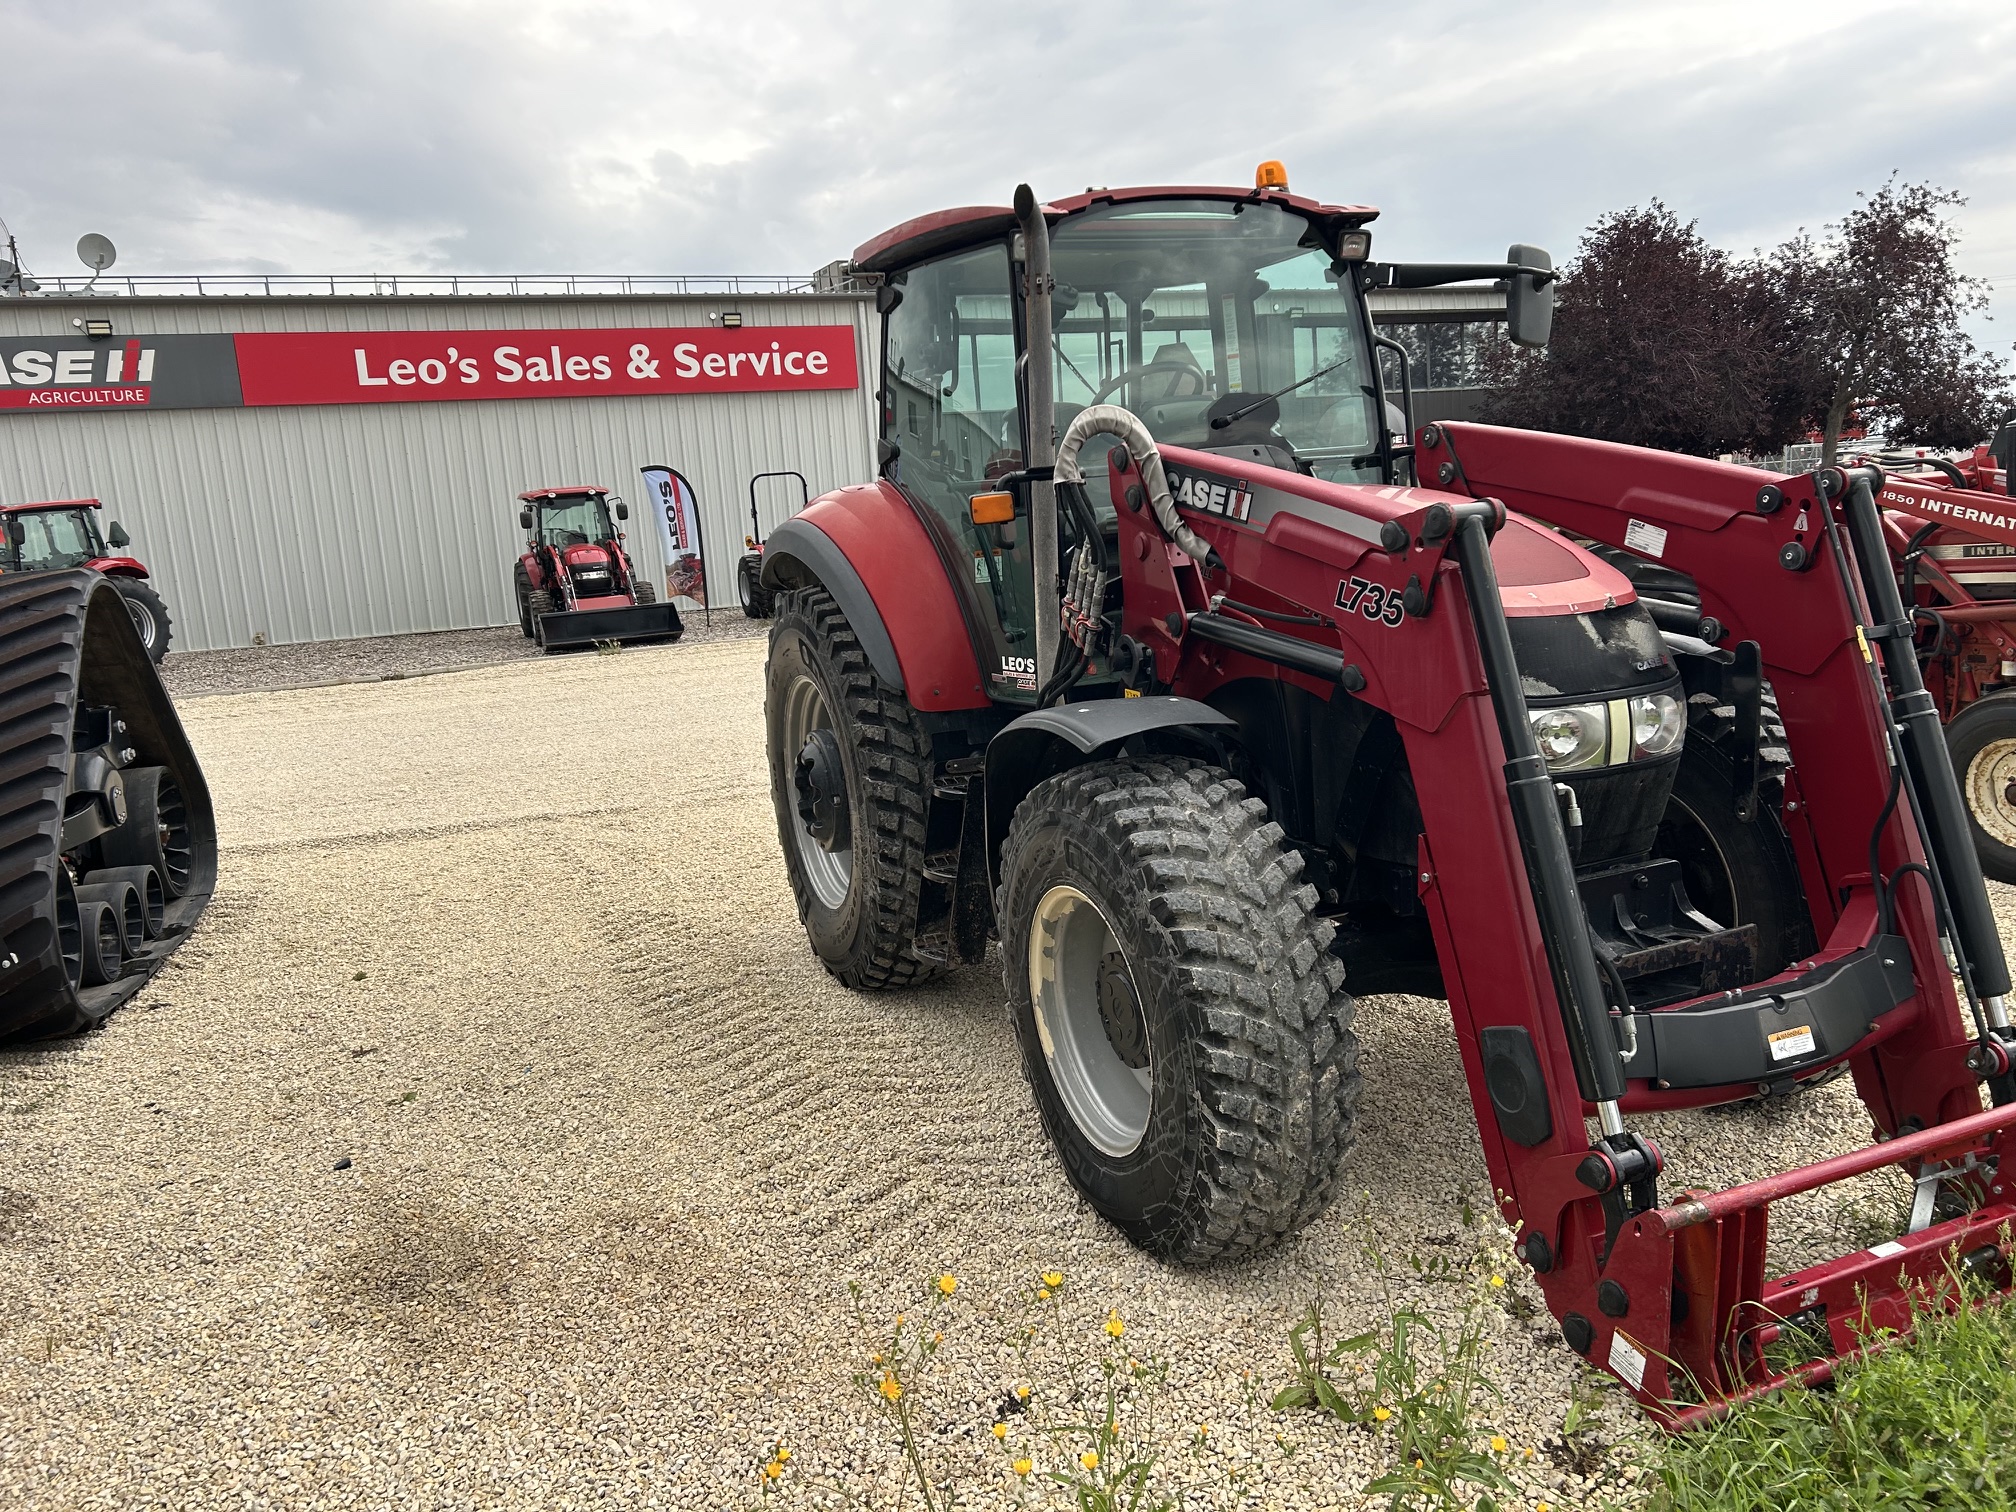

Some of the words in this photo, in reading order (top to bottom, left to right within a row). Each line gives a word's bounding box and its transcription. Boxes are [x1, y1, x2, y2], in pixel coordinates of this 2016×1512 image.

[493, 345, 612, 383] Sales
[626, 343, 661, 379] &
[673, 341, 829, 378] Service
[28, 389, 145, 404] AGRICULTURE
[1882, 490, 1915, 505] 1850
[1920, 497, 2016, 530] INTERNAT
[1334, 575, 1405, 628] L735
[1001, 655, 1035, 673] LEO'S
